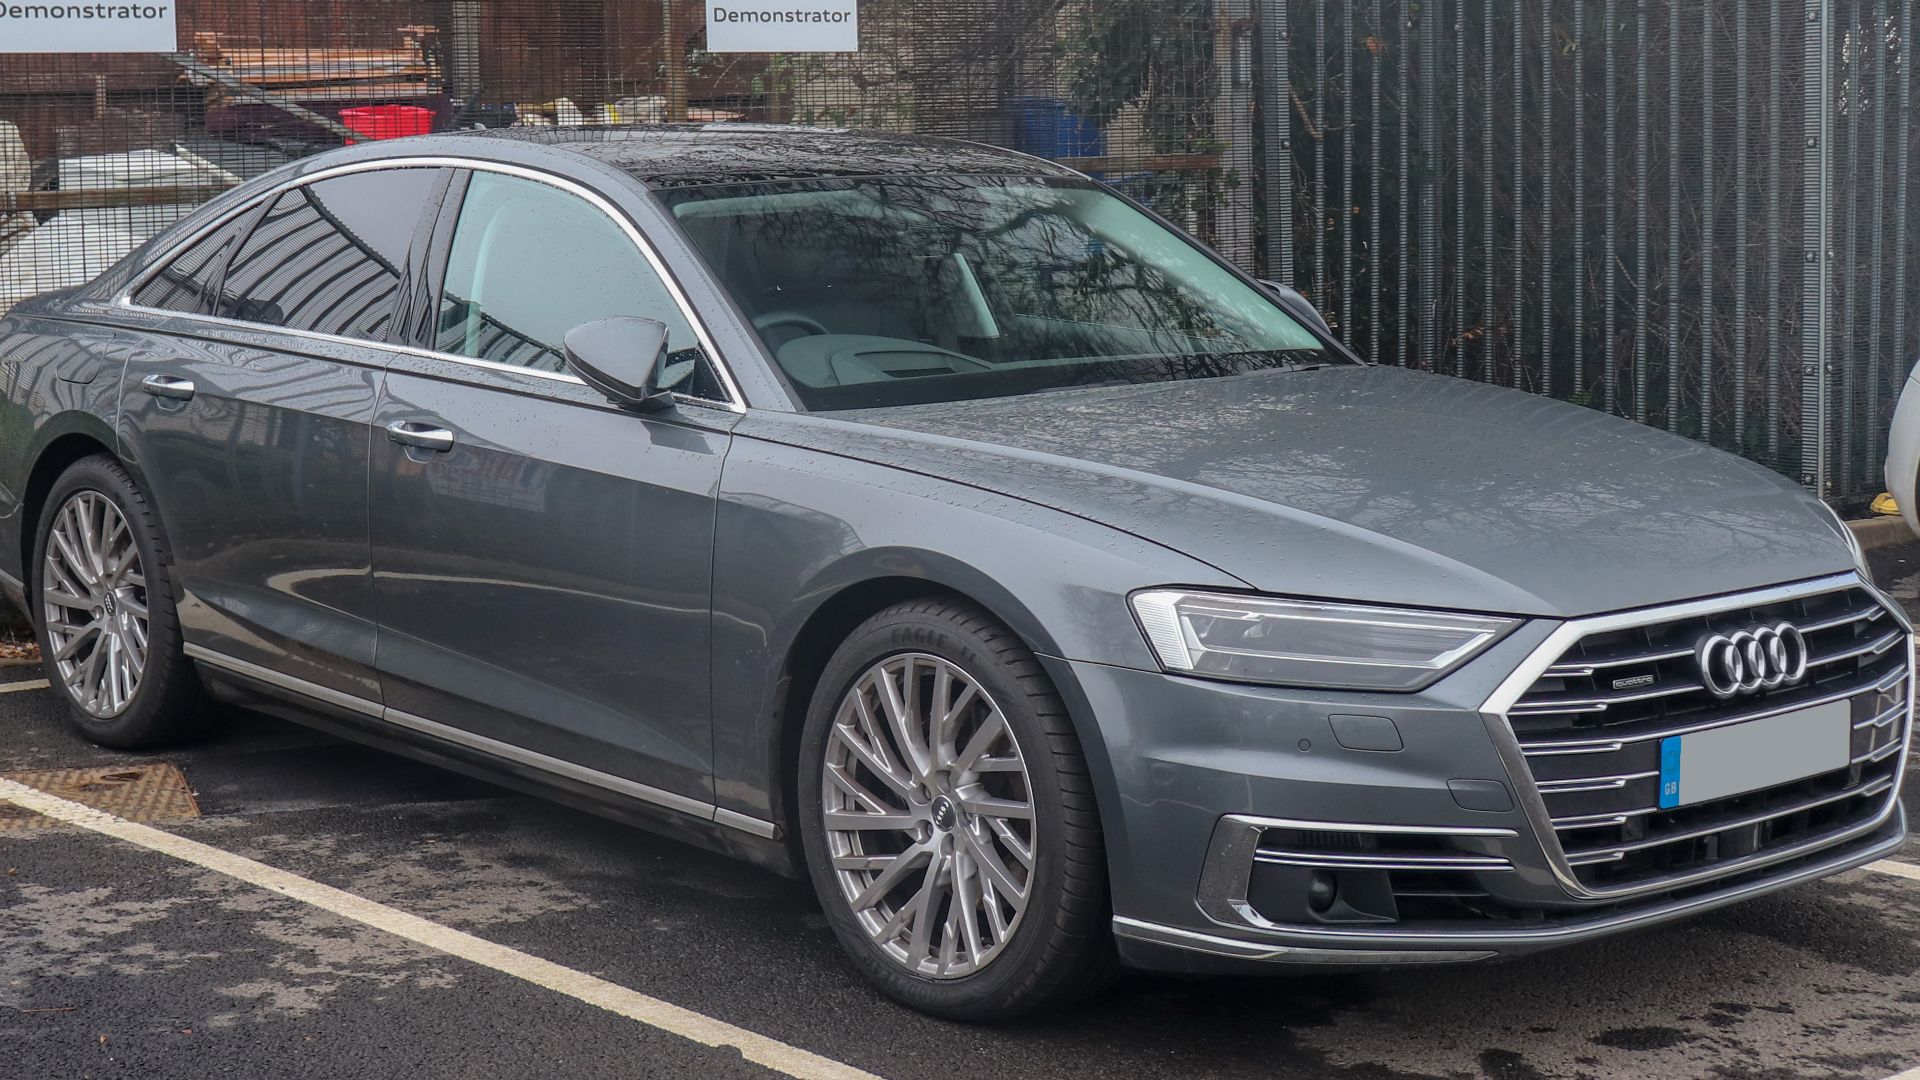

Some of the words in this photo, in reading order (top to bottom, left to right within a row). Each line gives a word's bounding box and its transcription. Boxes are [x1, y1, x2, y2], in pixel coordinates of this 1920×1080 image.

[713, 7, 851, 23] Demonstrator
[890, 626, 948, 648] EAGLE
[1615, 675, 1653, 689] quattro
[1664, 781, 1677, 796] GB
